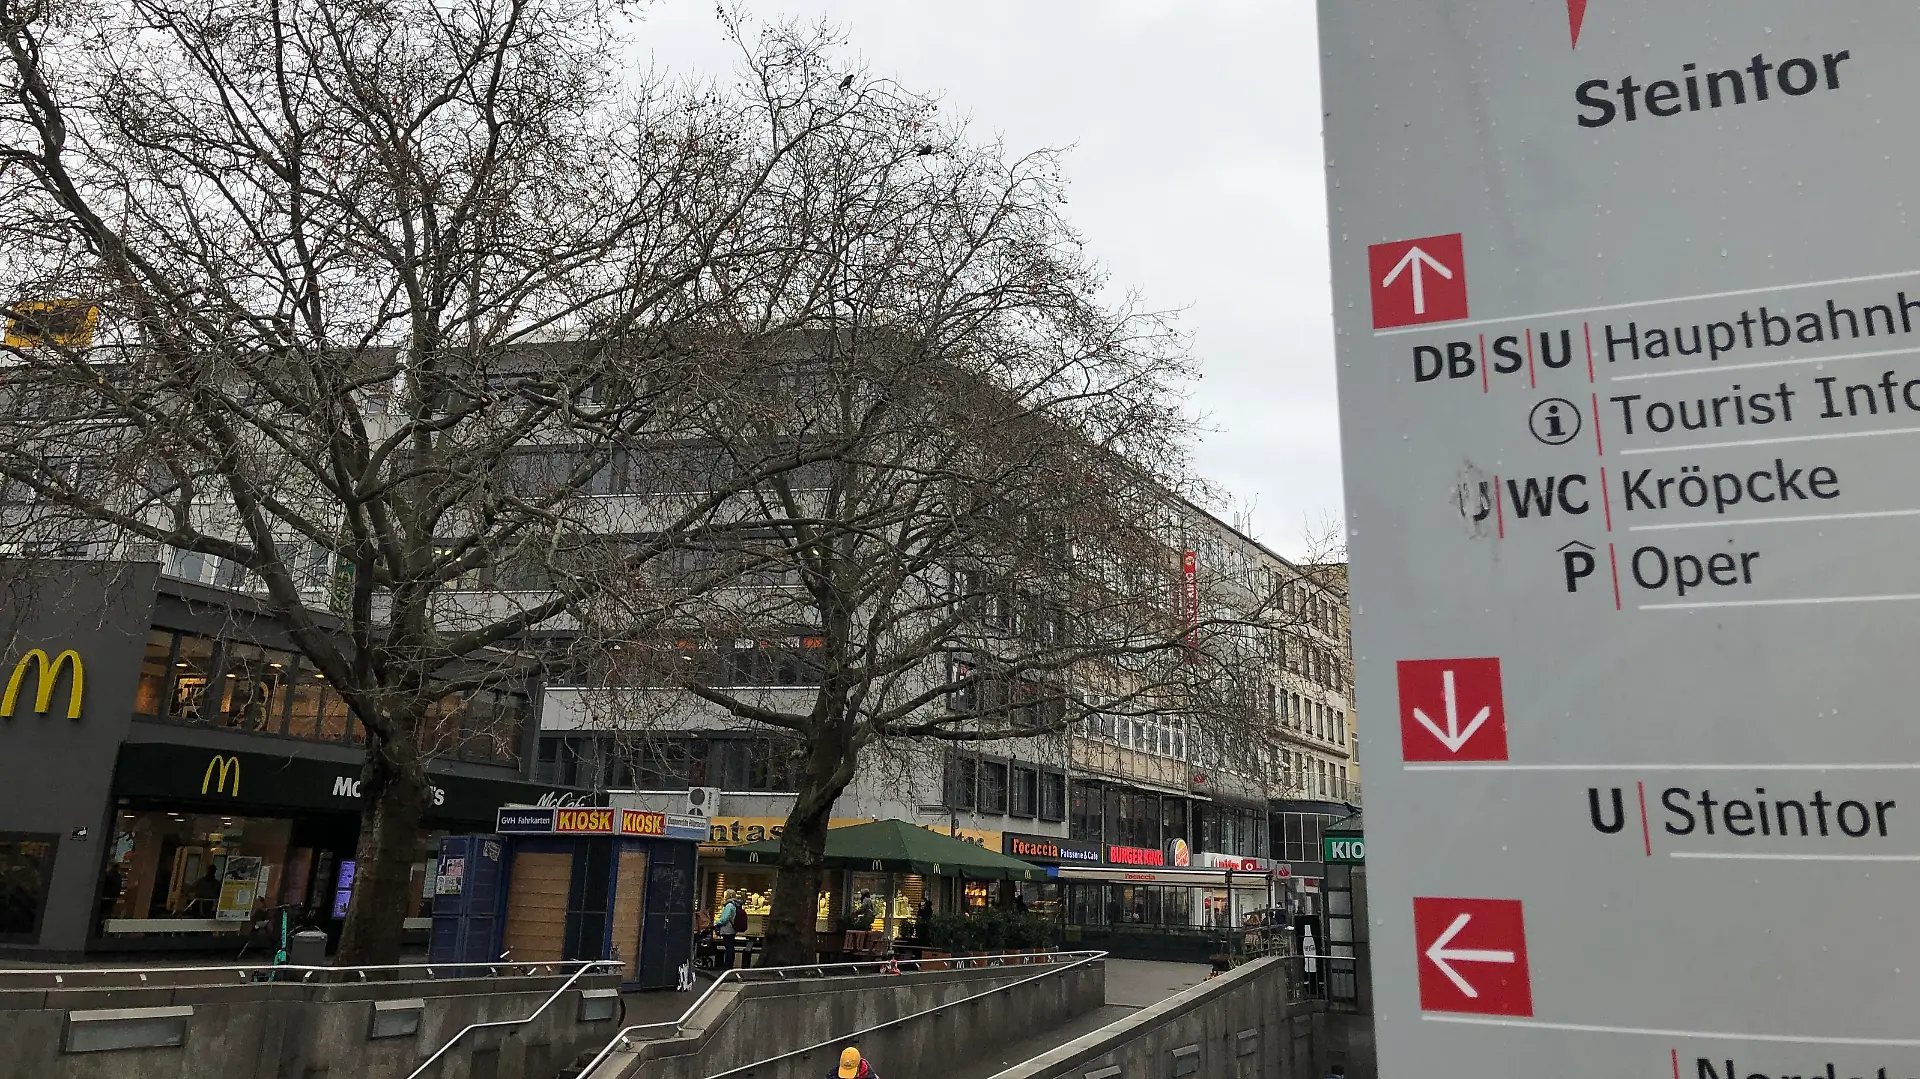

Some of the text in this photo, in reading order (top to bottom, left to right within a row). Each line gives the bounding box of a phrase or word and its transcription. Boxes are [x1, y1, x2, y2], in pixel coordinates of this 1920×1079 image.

[1575, 50, 1851, 128] Steintor
[1413, 292, 1920, 382] DB S U Hauptbahnh
[1610, 382, 1795, 435] Tourist
[1506, 473, 1591, 519] WC
[1623, 459, 1841, 514] Kröpcke
[1632, 545, 1760, 596] Oper
[501, 816, 550, 825] GVH Fahrkarten
[558, 811, 612, 830] KIOSK
[622, 812, 663, 833] KIOSK
[1588, 787, 1897, 838] U Steintor
[1013, 839, 1058, 857] Focaccia
[1110, 846, 1143, 864] BURGER
[1144, 850, 1163, 867] KING
